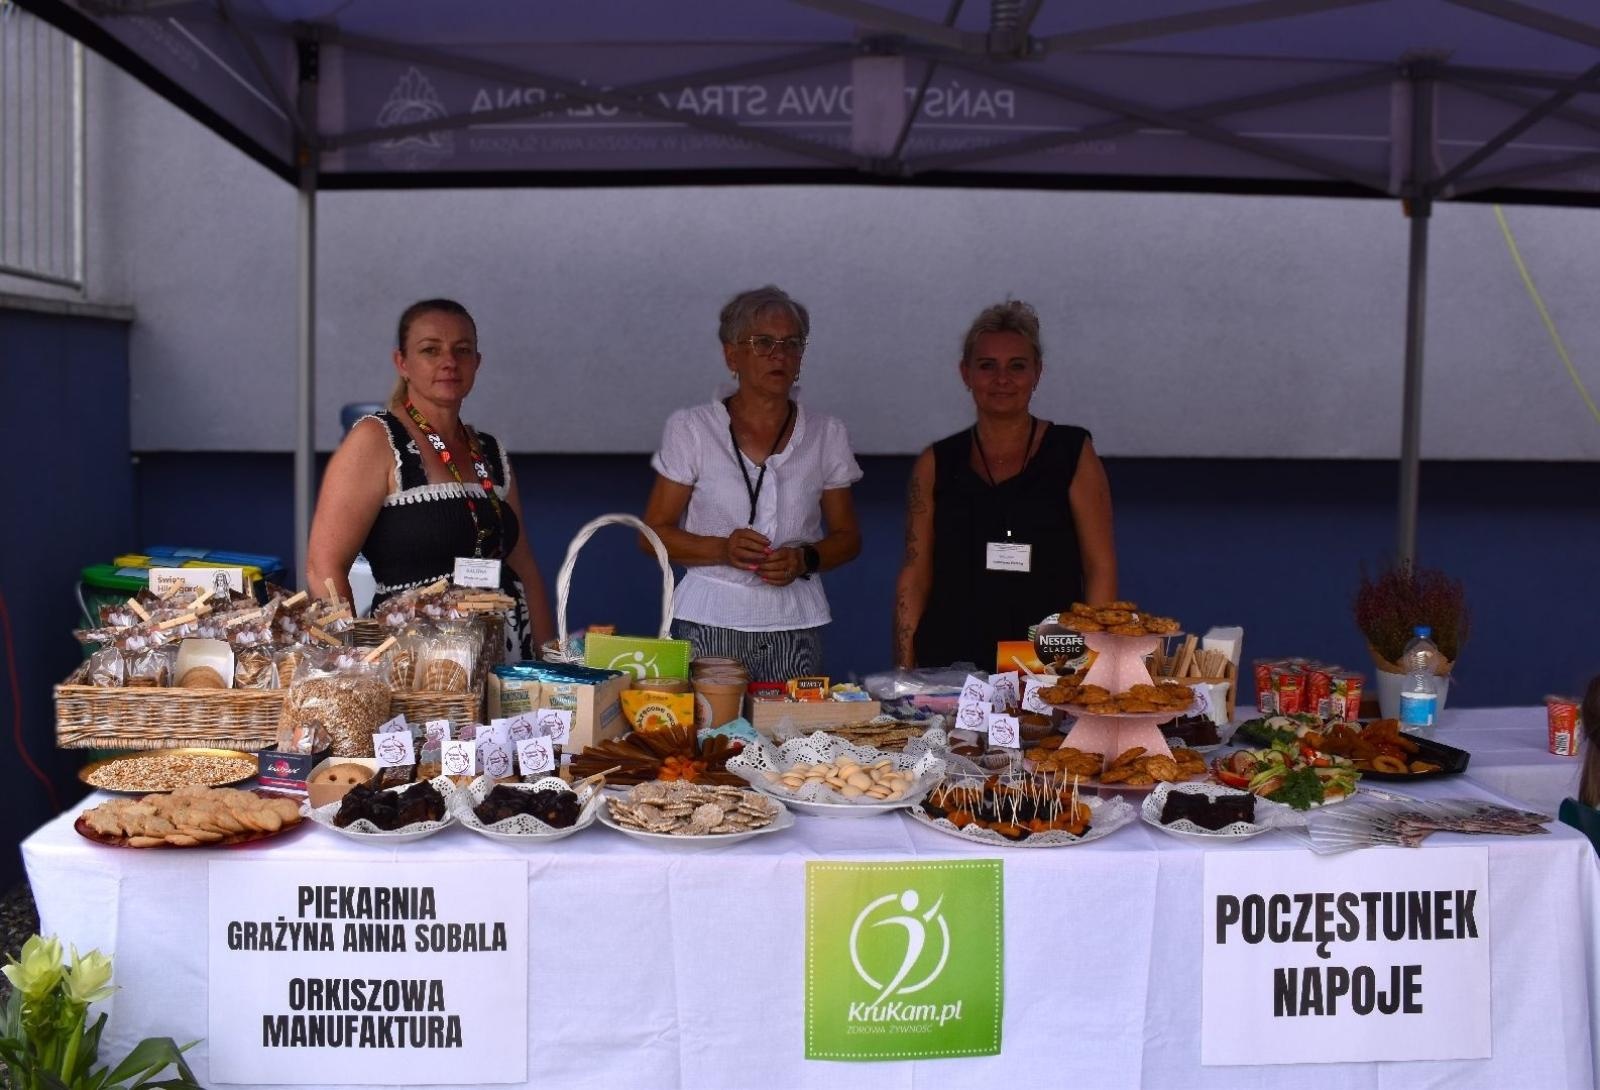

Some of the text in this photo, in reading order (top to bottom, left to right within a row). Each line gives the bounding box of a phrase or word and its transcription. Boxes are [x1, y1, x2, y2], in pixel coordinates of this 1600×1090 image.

[298, 885, 437, 920] PIEKARNIA
[227, 916, 508, 953] GRAŻYNA ANNA SOBALA
[1216, 889, 1479, 959] POCZĘSTUNEK
[289, 977, 445, 1012] ORKISZOWA
[1273, 965, 1423, 1017] NAPOJE
[848, 1000, 962, 1027] KruKam.pl
[262, 1014, 463, 1049] MANUFAKTURA
